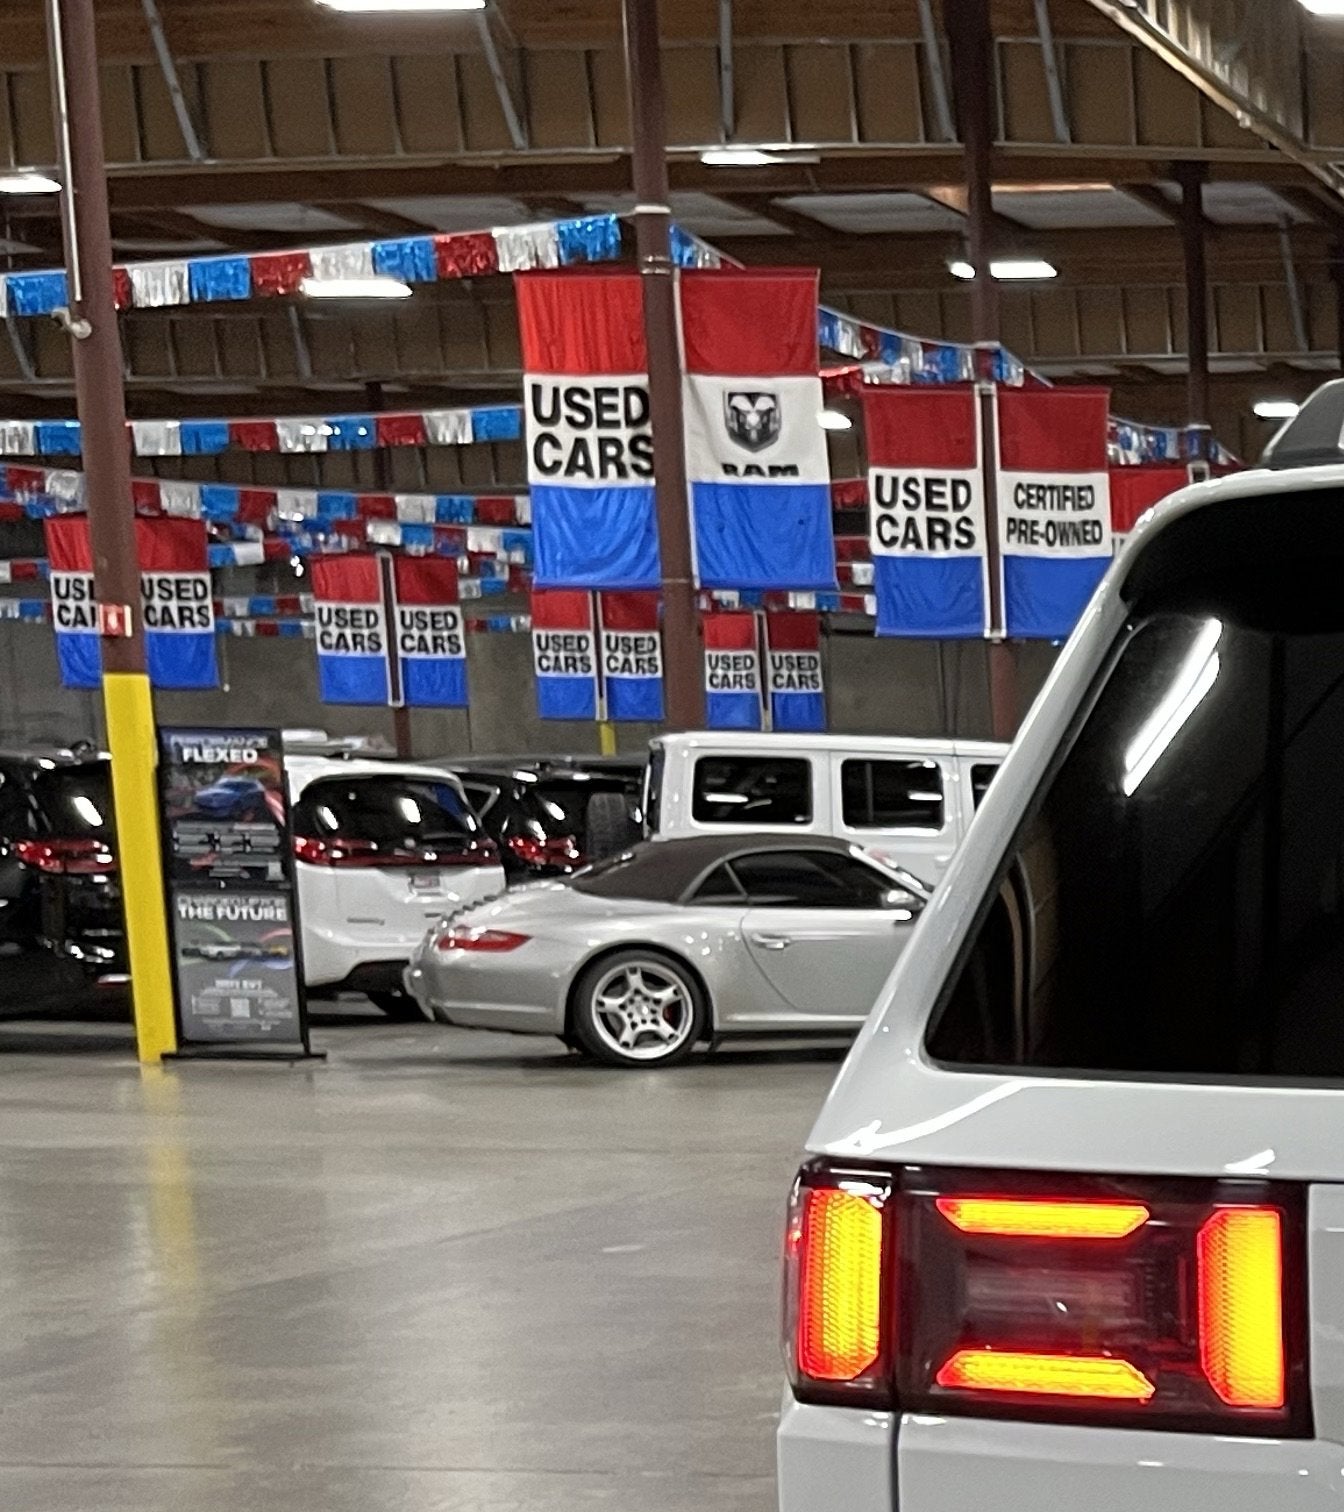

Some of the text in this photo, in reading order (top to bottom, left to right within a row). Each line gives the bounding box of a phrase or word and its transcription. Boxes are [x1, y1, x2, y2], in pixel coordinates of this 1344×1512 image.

[532, 383, 649, 430] USED
[533, 432, 654, 479] CARS
[721, 463, 799, 477] RAM
[875, 475, 972, 513] USED
[1013, 482, 1095, 512] CERTIFIED
[876, 513, 976, 551] CARS
[1006, 517, 1103, 547] PRE-OWNED
[141, 578, 208, 601] USED
[144, 604, 210, 628] CARS
[318, 607, 379, 629] USED
[401, 610, 458, 631] USED
[320, 631, 382, 651] CARS
[401, 634, 461, 655] CARS
[536, 633, 589, 652] USED
[605, 634, 657, 654] USED
[538, 655, 592, 673] CARS
[606, 656, 658, 674] CARS
[708, 652, 754, 670] USED
[771, 654, 818, 672] USED
[709, 672, 756, 690] CARS
[772, 673, 820, 690] CARS
[182, 747, 258, 764] FLEXED
[178, 904, 288, 922] THE FUTURE
